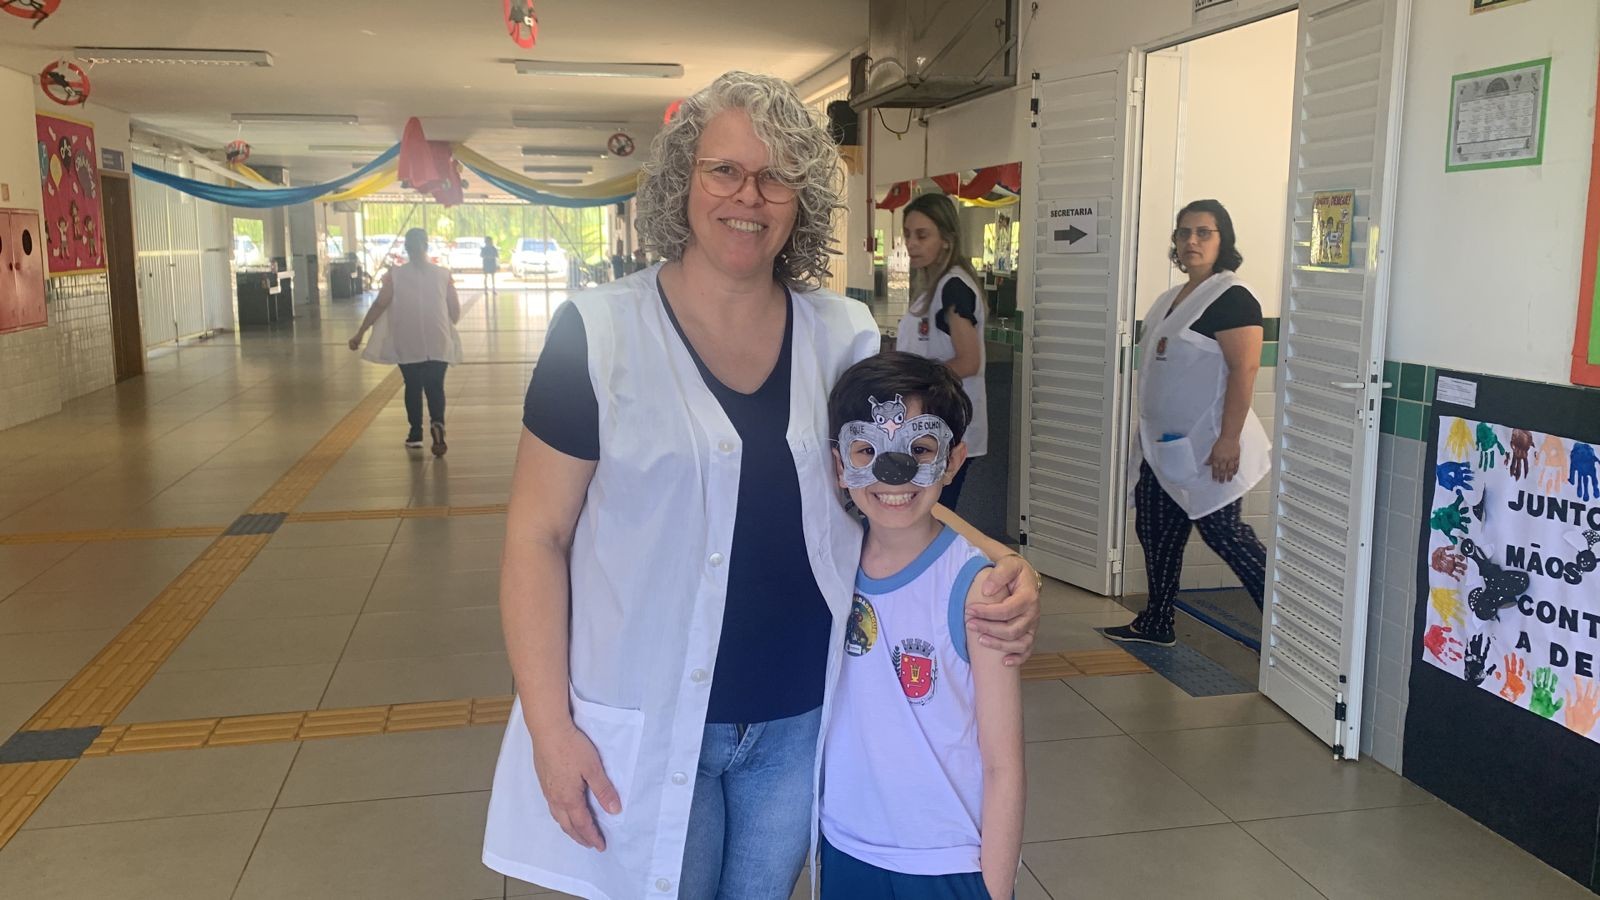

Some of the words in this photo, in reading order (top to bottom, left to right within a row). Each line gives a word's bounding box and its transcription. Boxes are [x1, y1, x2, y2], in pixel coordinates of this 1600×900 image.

[1051, 207, 1093, 217] SECRETARIA
[912, 421, 923, 431] DE
[1508, 490, 1600, 531] JUNTO
[1505, 543, 1582, 585] MÃOS
[1517, 594, 1600, 639] CONT
[1515, 631, 1532, 653] A
[1550, 642, 1600, 678] DE
